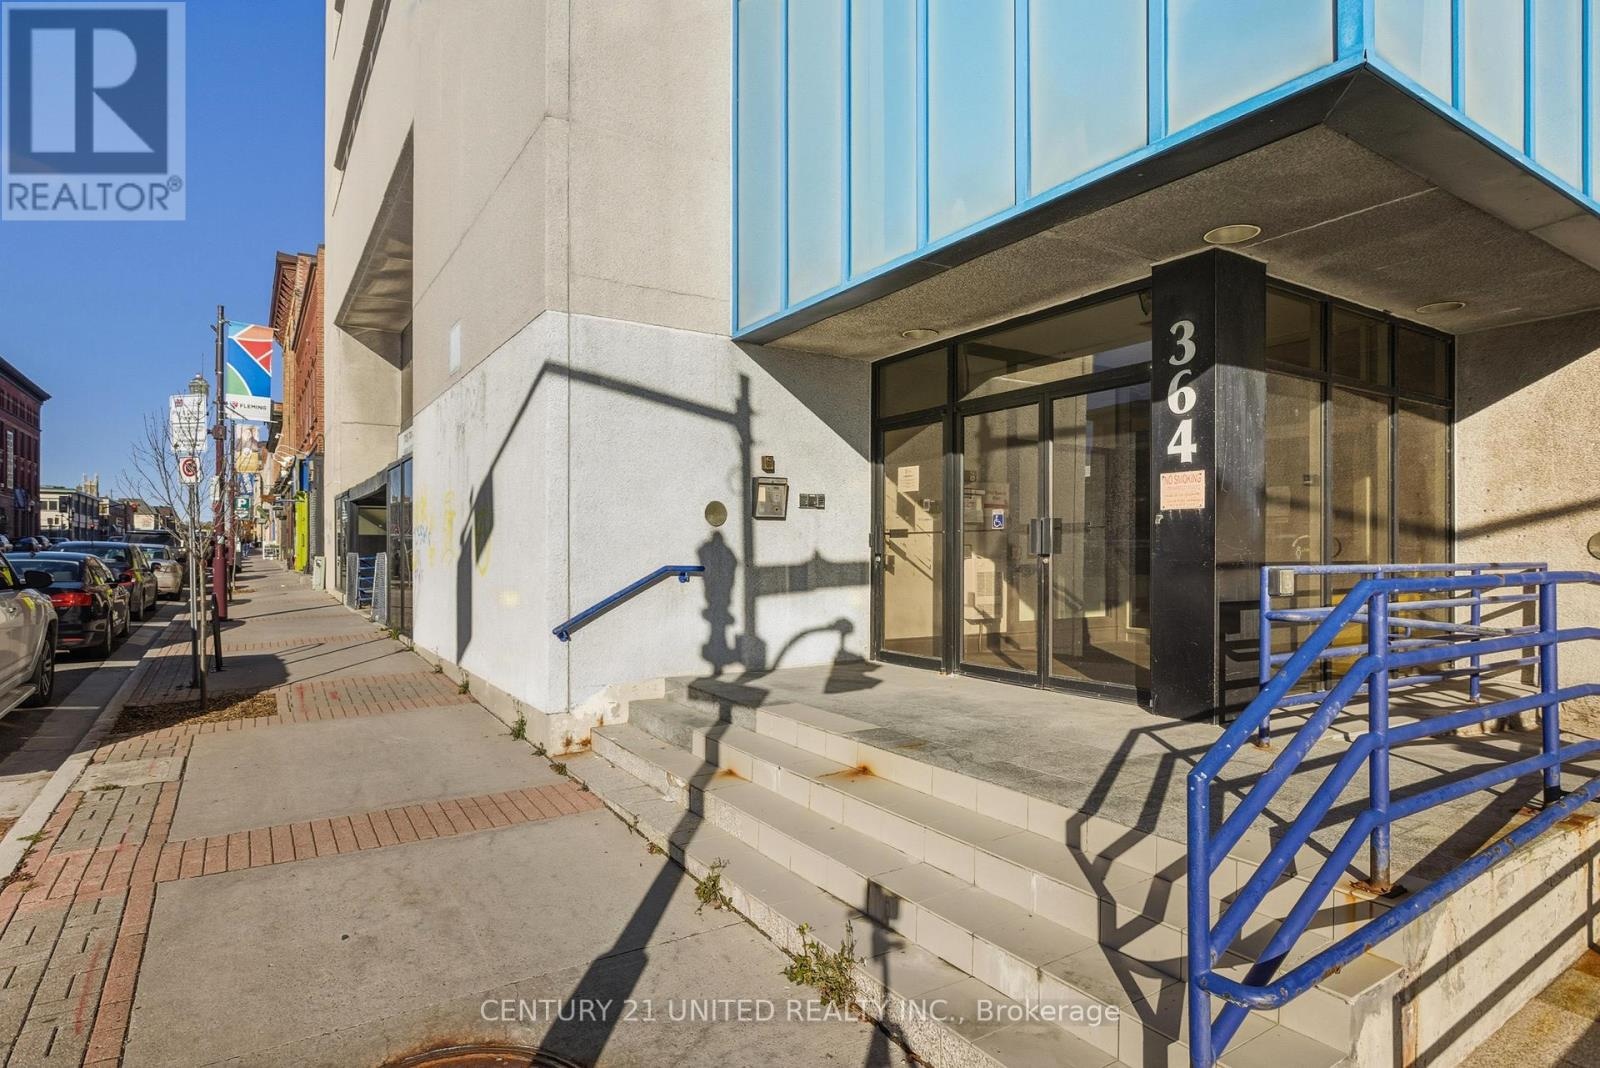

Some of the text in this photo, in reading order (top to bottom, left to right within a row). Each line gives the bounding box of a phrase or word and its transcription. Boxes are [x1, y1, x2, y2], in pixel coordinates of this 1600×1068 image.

[239, 403, 267, 411] FLEMING
[1164, 473, 1202, 485] NO SMOKING
[237, 498, 247, 508] P
